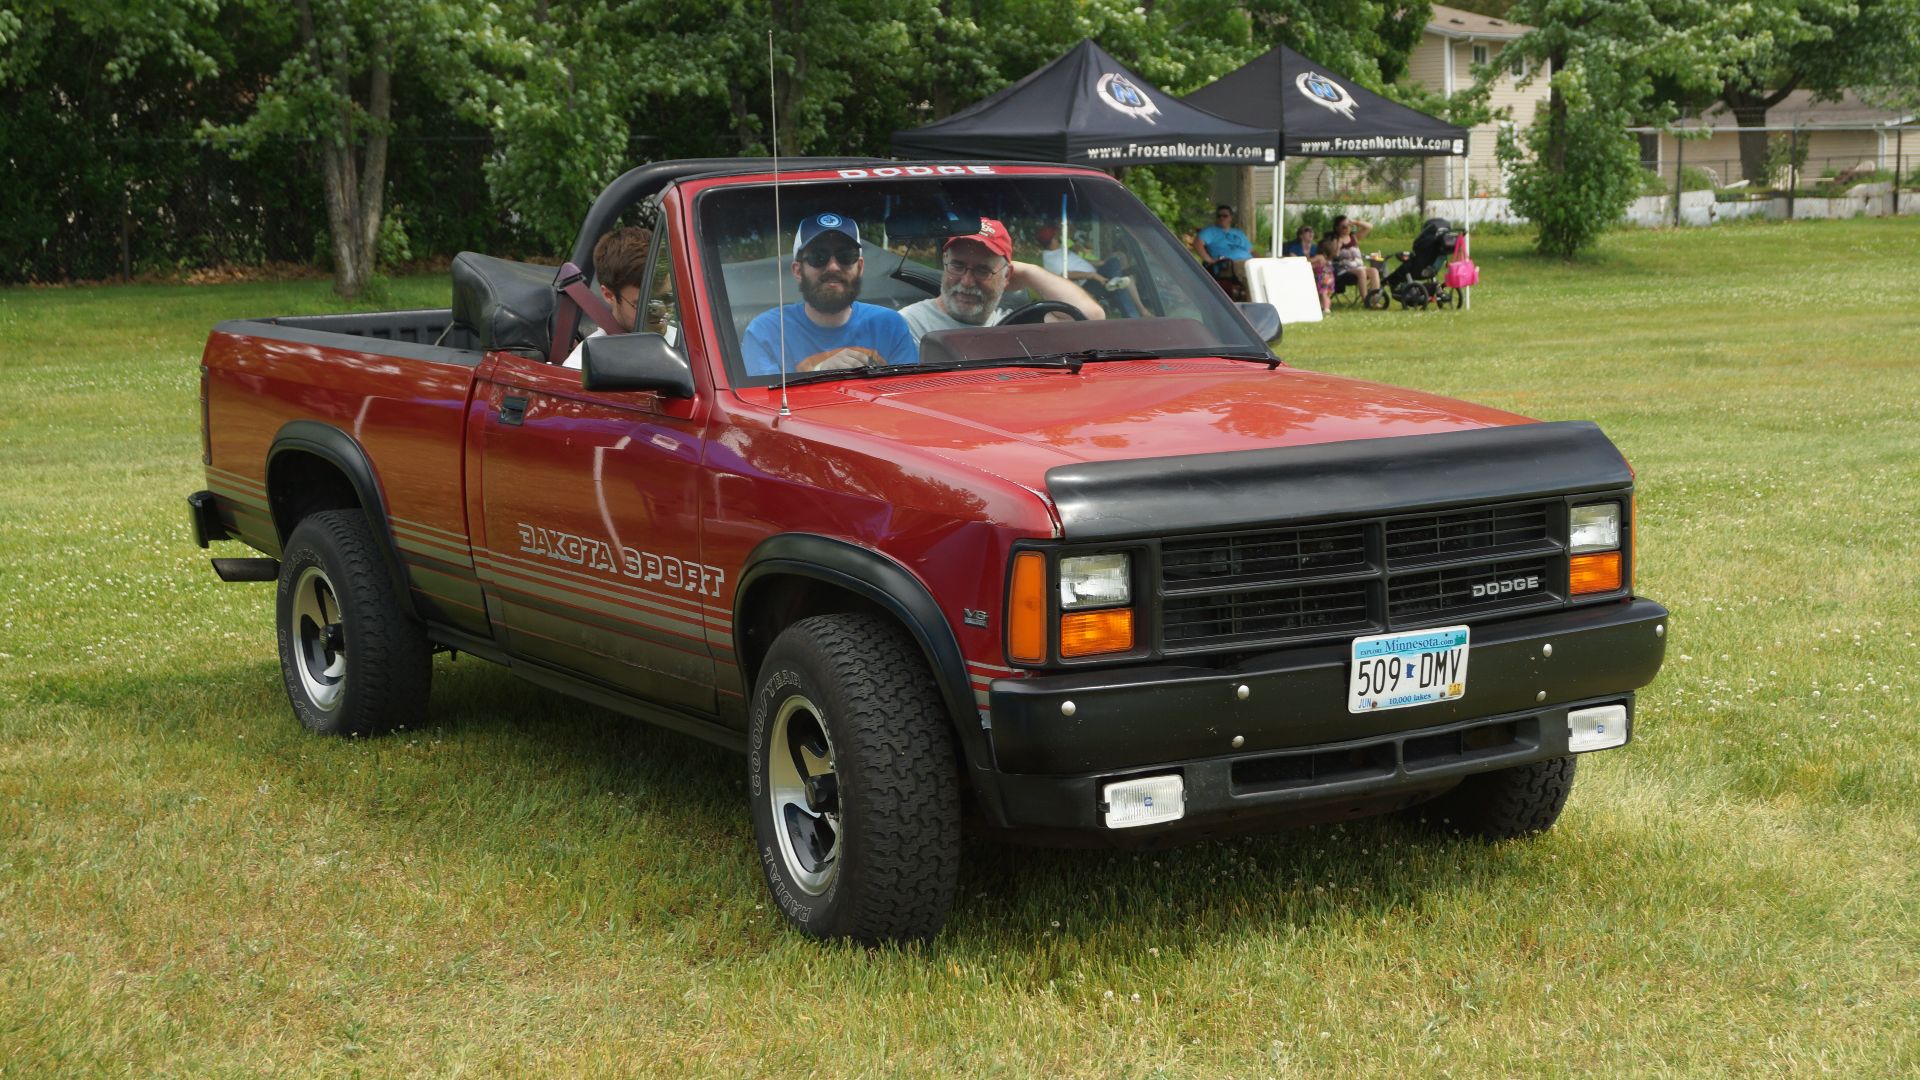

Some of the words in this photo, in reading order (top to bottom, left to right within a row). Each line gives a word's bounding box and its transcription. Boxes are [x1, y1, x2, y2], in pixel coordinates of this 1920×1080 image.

[1088, 143, 1262, 159] www.FrozenNorthLX.com
[1302, 136, 1451, 153] www.FrozenNorthLX.com
[838, 165, 996, 179] DODGE
[517, 522, 618, 574] DAKOTA
[623, 546, 725, 598] SPORT
[1472, 576, 1539, 597] DODGE
[1385, 638, 1454, 652] Minnesota.com
[1358, 657, 1401, 696] 509
[1419, 648, 1462, 689] DMV
[1389, 696, 1412, 705] 10,000
[1413, 693, 1432, 702] lakes
[751, 668, 802, 797] GOODYEAR
[764, 845, 812, 923] RADIAL
